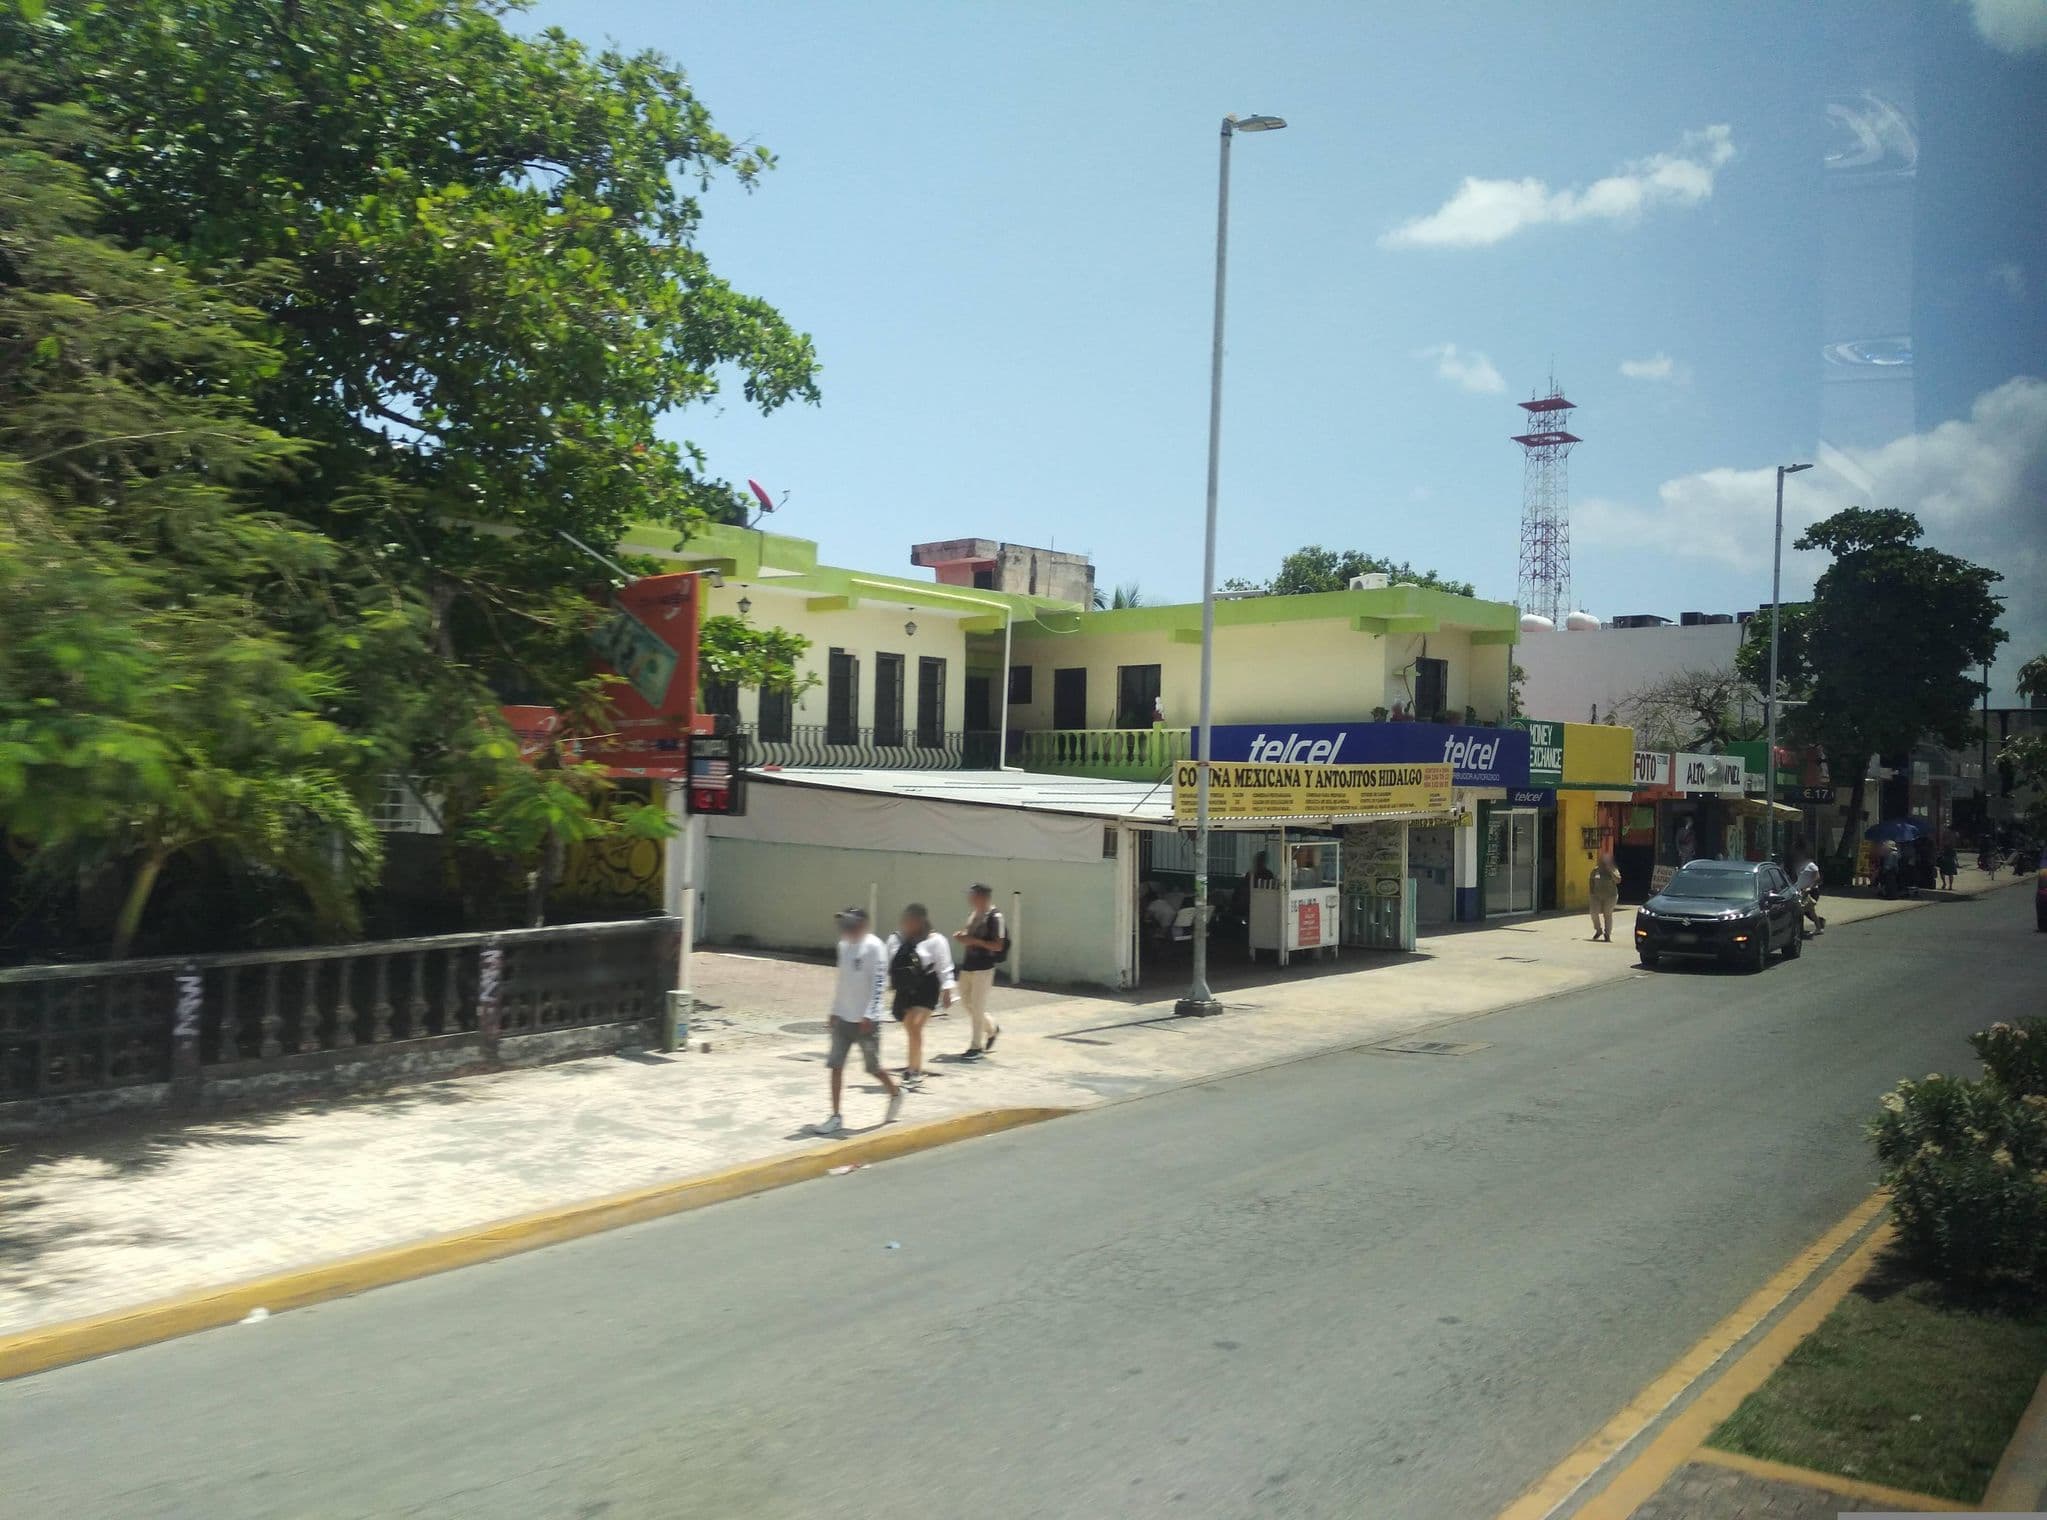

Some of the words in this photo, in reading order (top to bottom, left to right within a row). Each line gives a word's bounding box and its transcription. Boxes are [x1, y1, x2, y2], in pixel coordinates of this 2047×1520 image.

[1248, 732, 1347, 763] telcel
[1443, 734, 1500, 770] telcel
[1530, 746, 1562, 768] EXCHANGE
[1178, 767, 1231, 787] COINA
[1234, 768, 1301, 787] MEXICANA
[1304, 769, 1313, 787] Y
[1315, 769, 1377, 788] ANTOJITOS
[1378, 768, 1422, 786] HIDALGO
[1634, 753, 1656, 781] FOTO
[1687, 762, 1705, 785] ALTO
[1514, 791, 1544, 802] telcel
